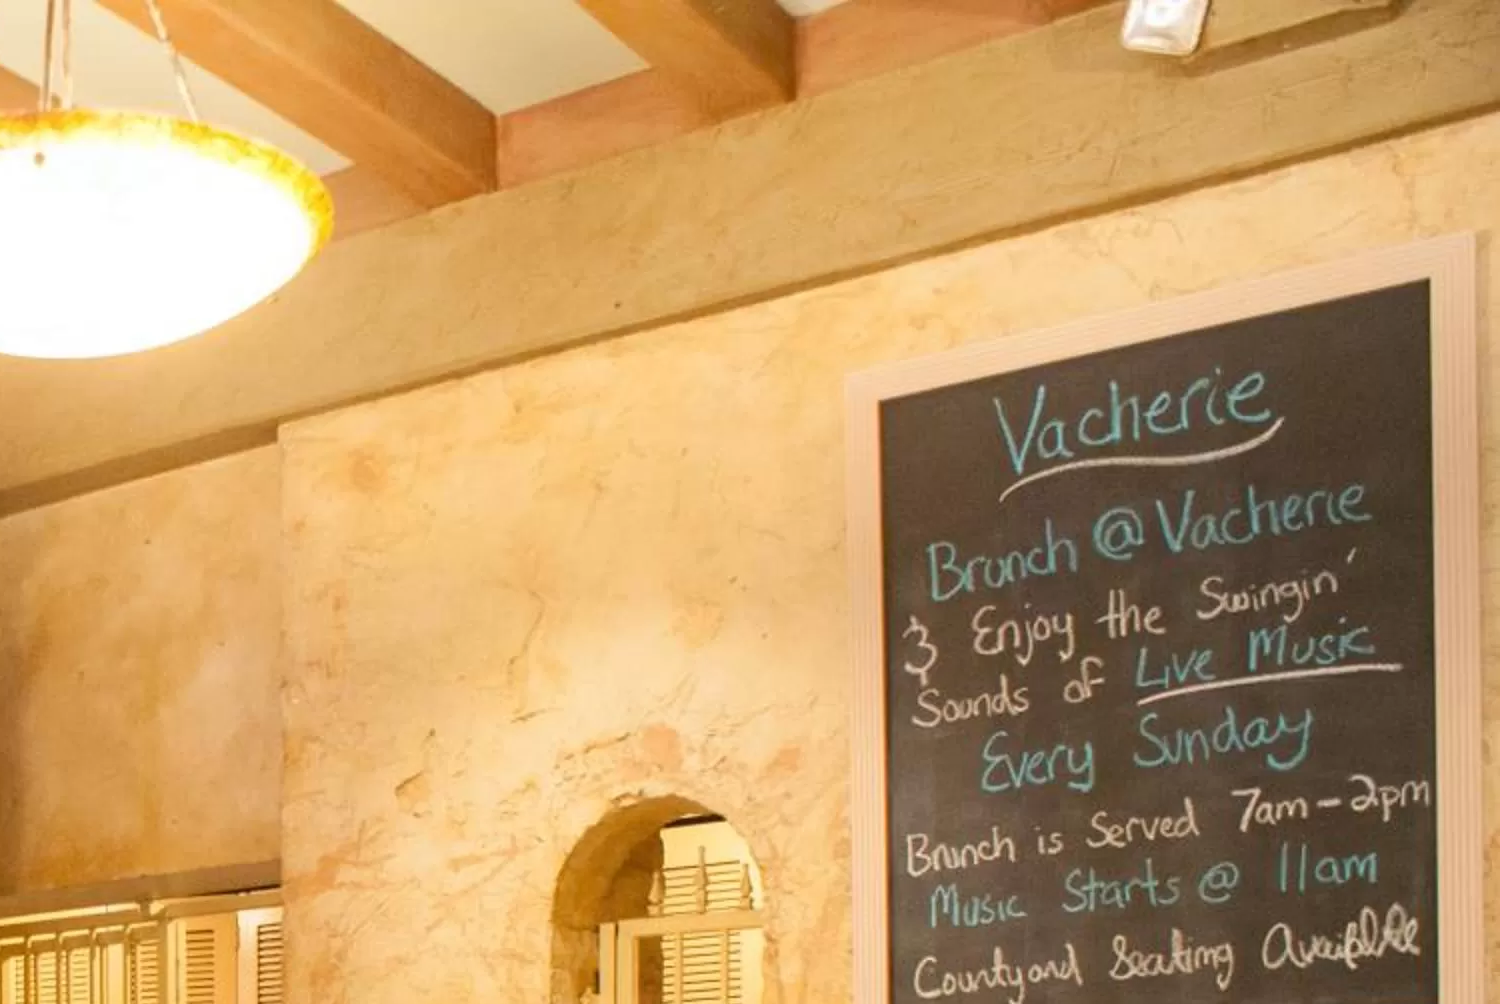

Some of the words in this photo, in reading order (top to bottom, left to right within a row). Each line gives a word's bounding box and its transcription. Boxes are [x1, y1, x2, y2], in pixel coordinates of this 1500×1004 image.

[994, 368, 1271, 474] Vacherie
[927, 519, 1078, 600] Brunch
[1094, 507, 1143, 559] @
[1156, 484, 1372, 552] Vacherie
[972, 603, 1074, 666] Enjoy
[1095, 589, 1166, 639] the
[912, 674, 1029, 727] Sounds
[1064, 656, 1105, 703] of
[1137, 647, 1216, 688] Live
[1249, 617, 1375, 672] Music
[982, 731, 1093, 792] Every
[1134, 706, 1313, 770] Sunday
[906, 825, 1015, 877] Brunch
[1034, 826, 1063, 854] is
[1087, 797, 1199, 848] Served
[930, 884, 1027, 928] Music
[1062, 858, 1181, 912] Starts
[1199, 861, 1239, 903] @
[1279, 843, 1378, 892] 11am
[1109, 927, 1234, 991] Seating
